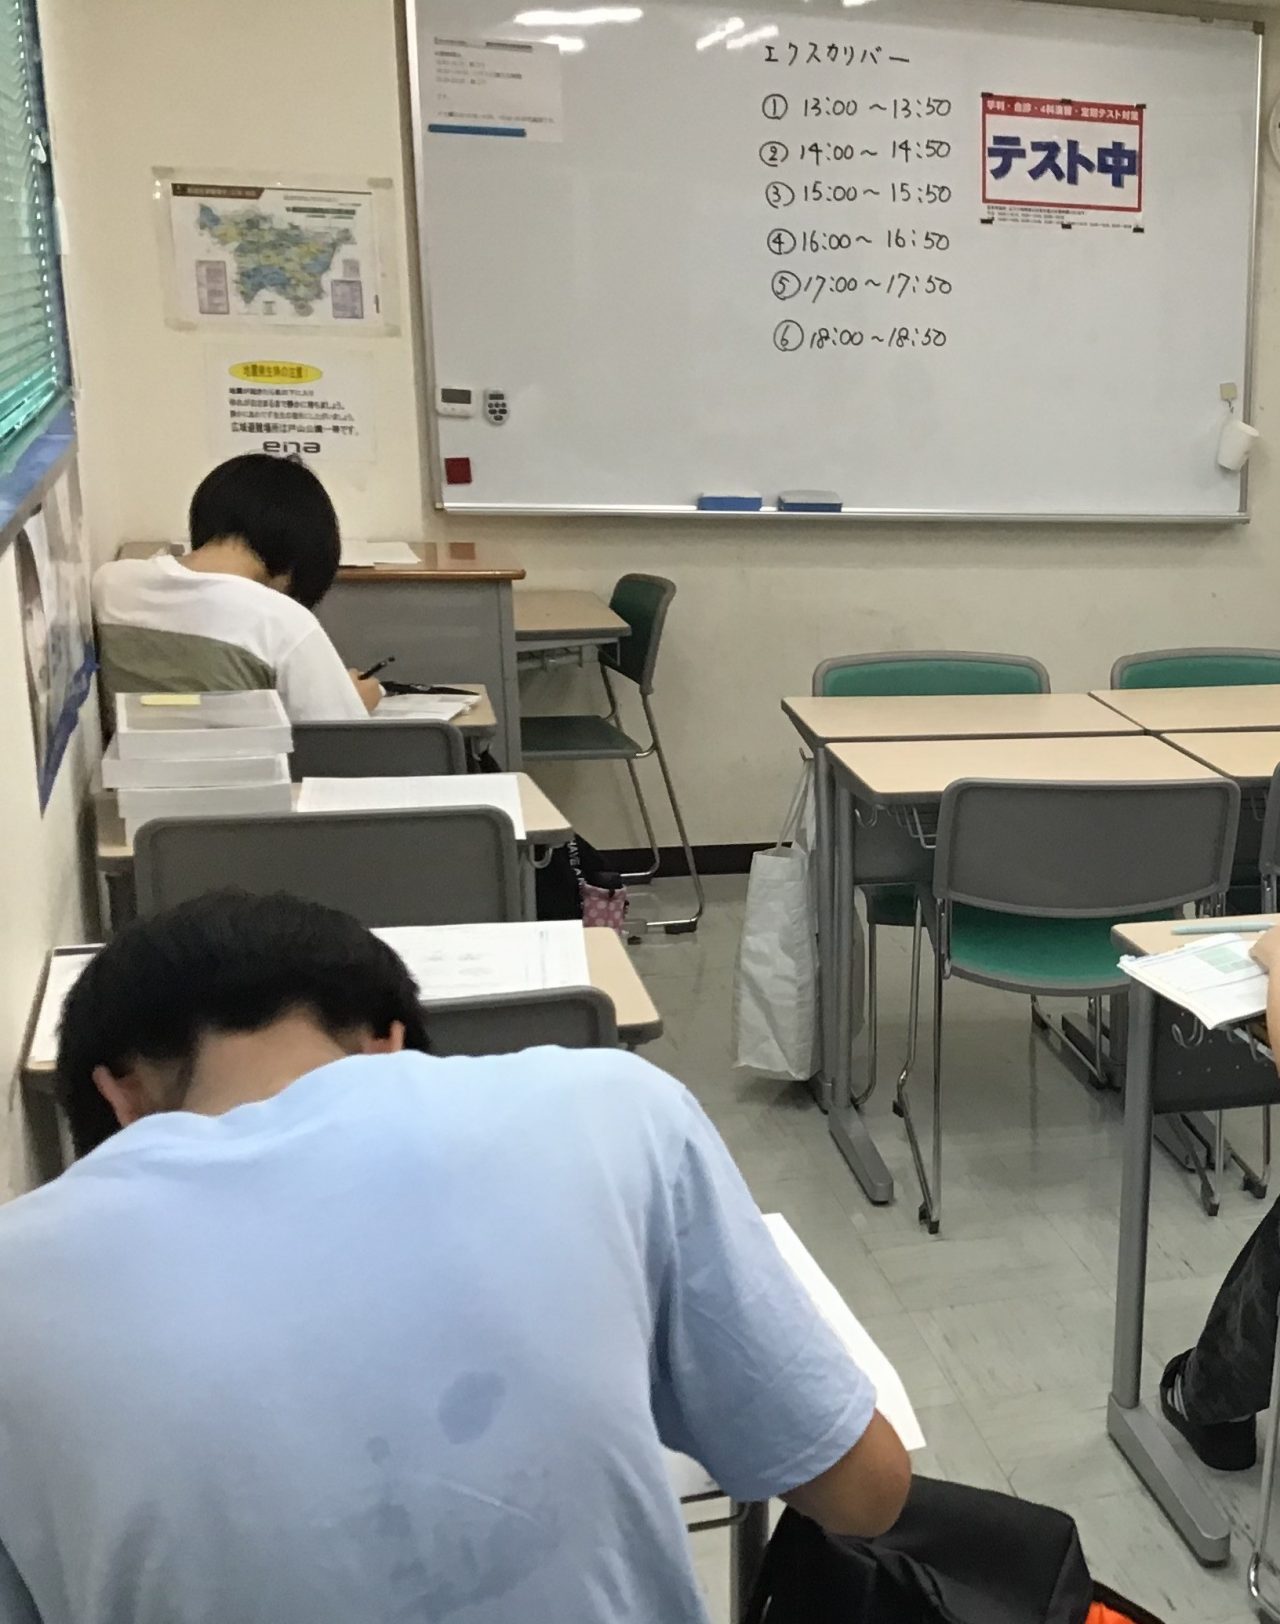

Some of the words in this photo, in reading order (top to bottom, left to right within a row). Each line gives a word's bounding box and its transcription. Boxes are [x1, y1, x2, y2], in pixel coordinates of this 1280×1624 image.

[764, 41, 910, 66] エクスカリバー
[987, 134, 1138, 189] テスト中
[262, 440, 322, 454] ena
